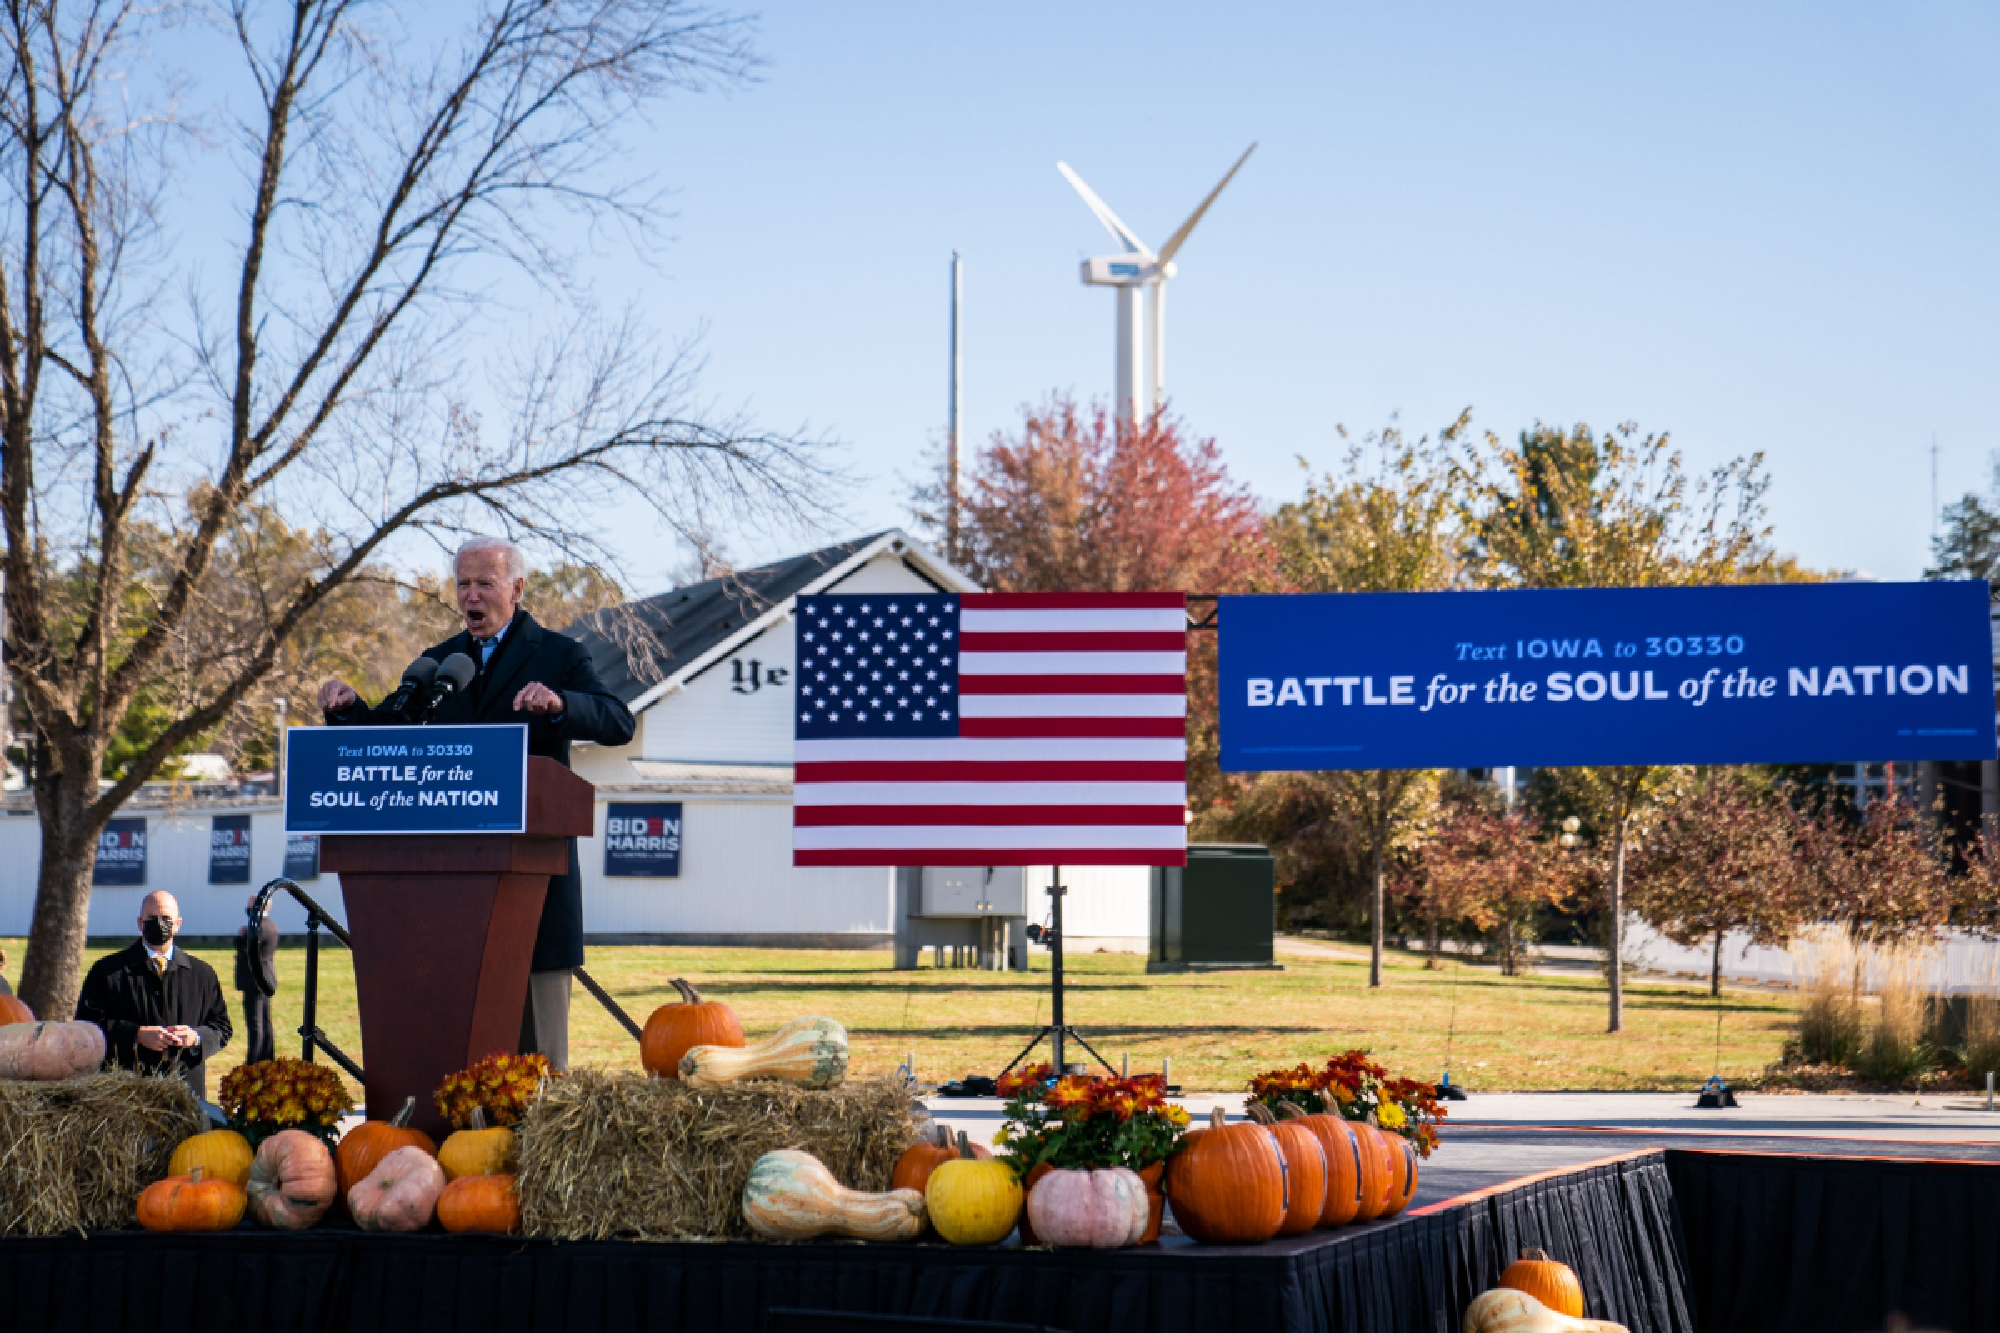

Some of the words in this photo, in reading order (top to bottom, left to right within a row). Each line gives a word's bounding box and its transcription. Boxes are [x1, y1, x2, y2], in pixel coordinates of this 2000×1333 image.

[1456, 641, 1507, 661] Text
[1516, 637, 1603, 659] IOWA
[1614, 640, 1637, 657] to
[1645, 634, 1744, 656] 30330
[1247, 676, 1415, 707] BATTLE
[1419, 673, 1477, 712] for
[1484, 672, 1537, 703] the
[1546, 669, 1668, 702] SOUL
[1679, 668, 1720, 706] of
[1722, 666, 1777, 699] the
[1788, 664, 1969, 696] NATION
[338, 745, 363, 757] Text
[367, 745, 408, 757] IOWA
[412, 746, 424, 757] to
[427, 744, 473, 757] 30330
[337, 765, 417, 781] BATTLE
[418, 765, 445, 785] for
[447, 765, 473, 781] the
[310, 791, 365, 808] SOUL
[370, 790, 389, 811] of
[389, 790, 414, 807] the
[418, 790, 498, 807] NATION
[607, 817, 680, 836] BIDEN
[98, 830, 145, 848] IDEN
[607, 836, 681, 851] HARRIS
[97, 848, 144, 861] ARRIS
